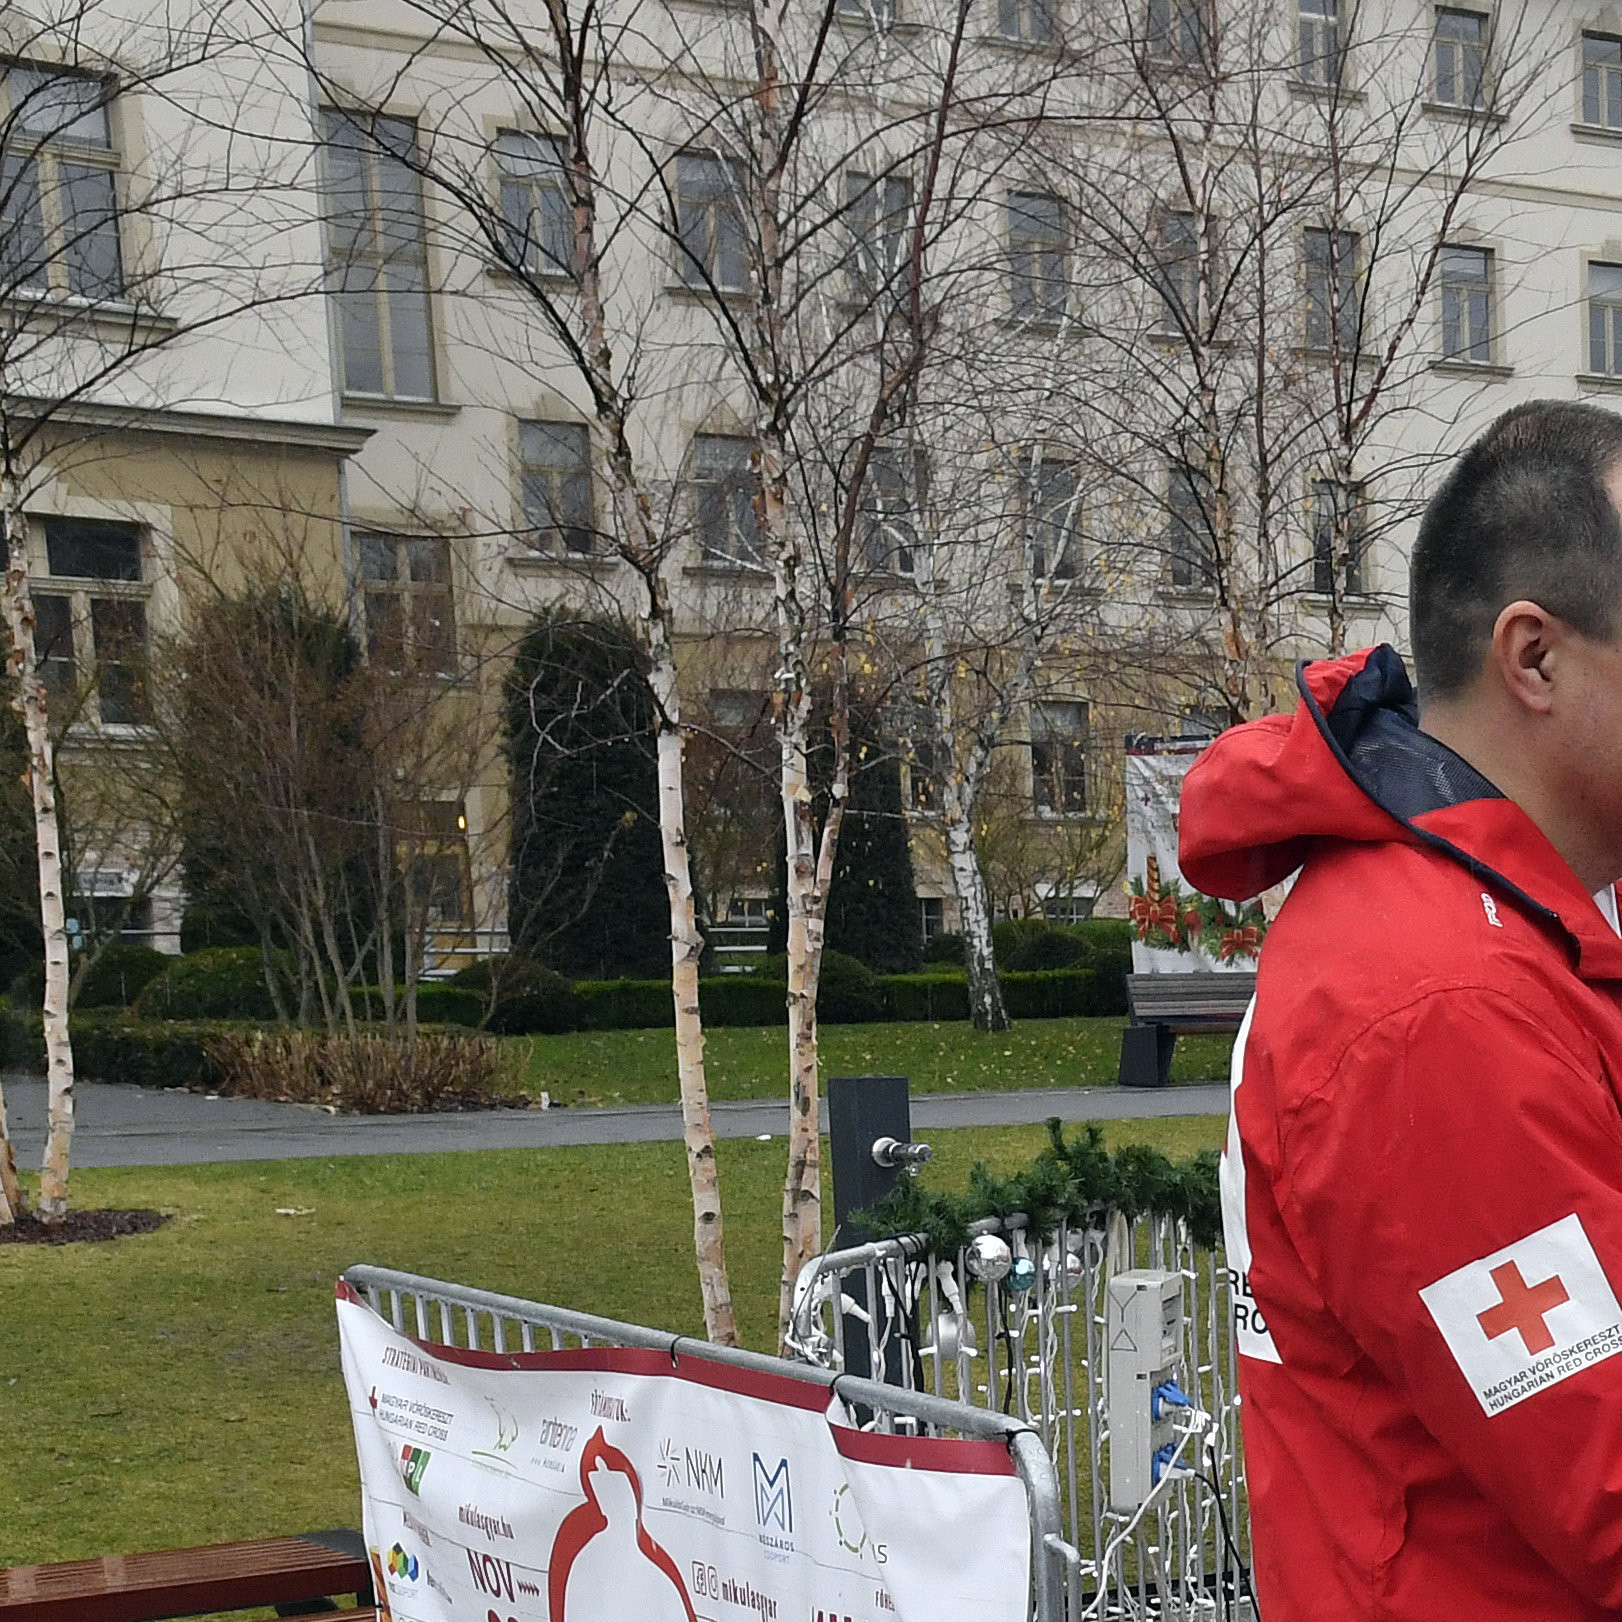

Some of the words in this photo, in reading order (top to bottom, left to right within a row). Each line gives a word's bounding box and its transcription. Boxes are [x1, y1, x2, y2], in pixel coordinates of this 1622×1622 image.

[1227, 1267, 1253, 1297] RE
[1483, 1370, 1528, 1400] MAGYAR
[1528, 1323, 1622, 1376] VÖRÖSKERESZT
[1488, 1372, 1555, 1411] HUNGARIAN
[1557, 1357, 1583, 1376] RED
[685, 1446, 724, 1499] NKM
[466, 1547, 516, 1604] NOV
